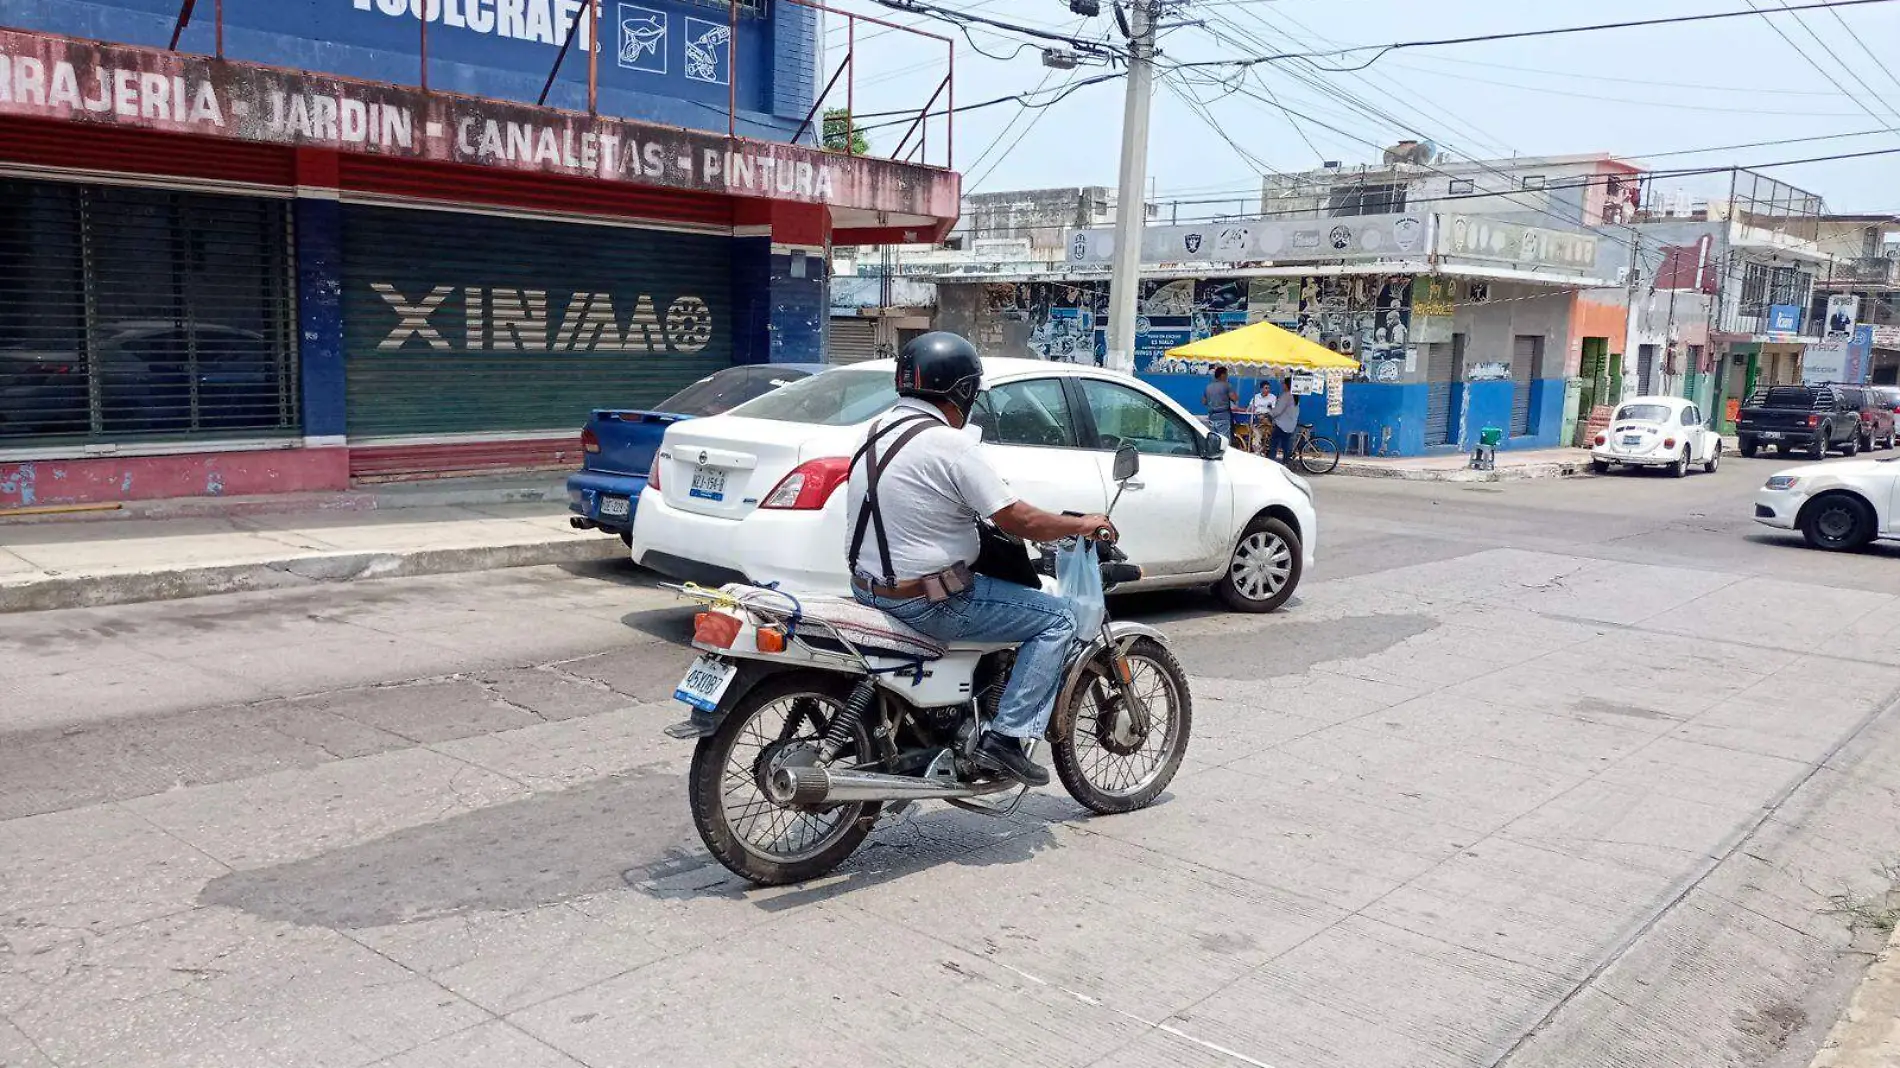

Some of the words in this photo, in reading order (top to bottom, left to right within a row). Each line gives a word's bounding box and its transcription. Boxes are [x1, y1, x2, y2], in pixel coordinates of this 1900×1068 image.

[266, 91, 412, 148] JARDIN
[456, 116, 665, 177] CANALETAS
[703, 148, 834, 199] PINTURA
